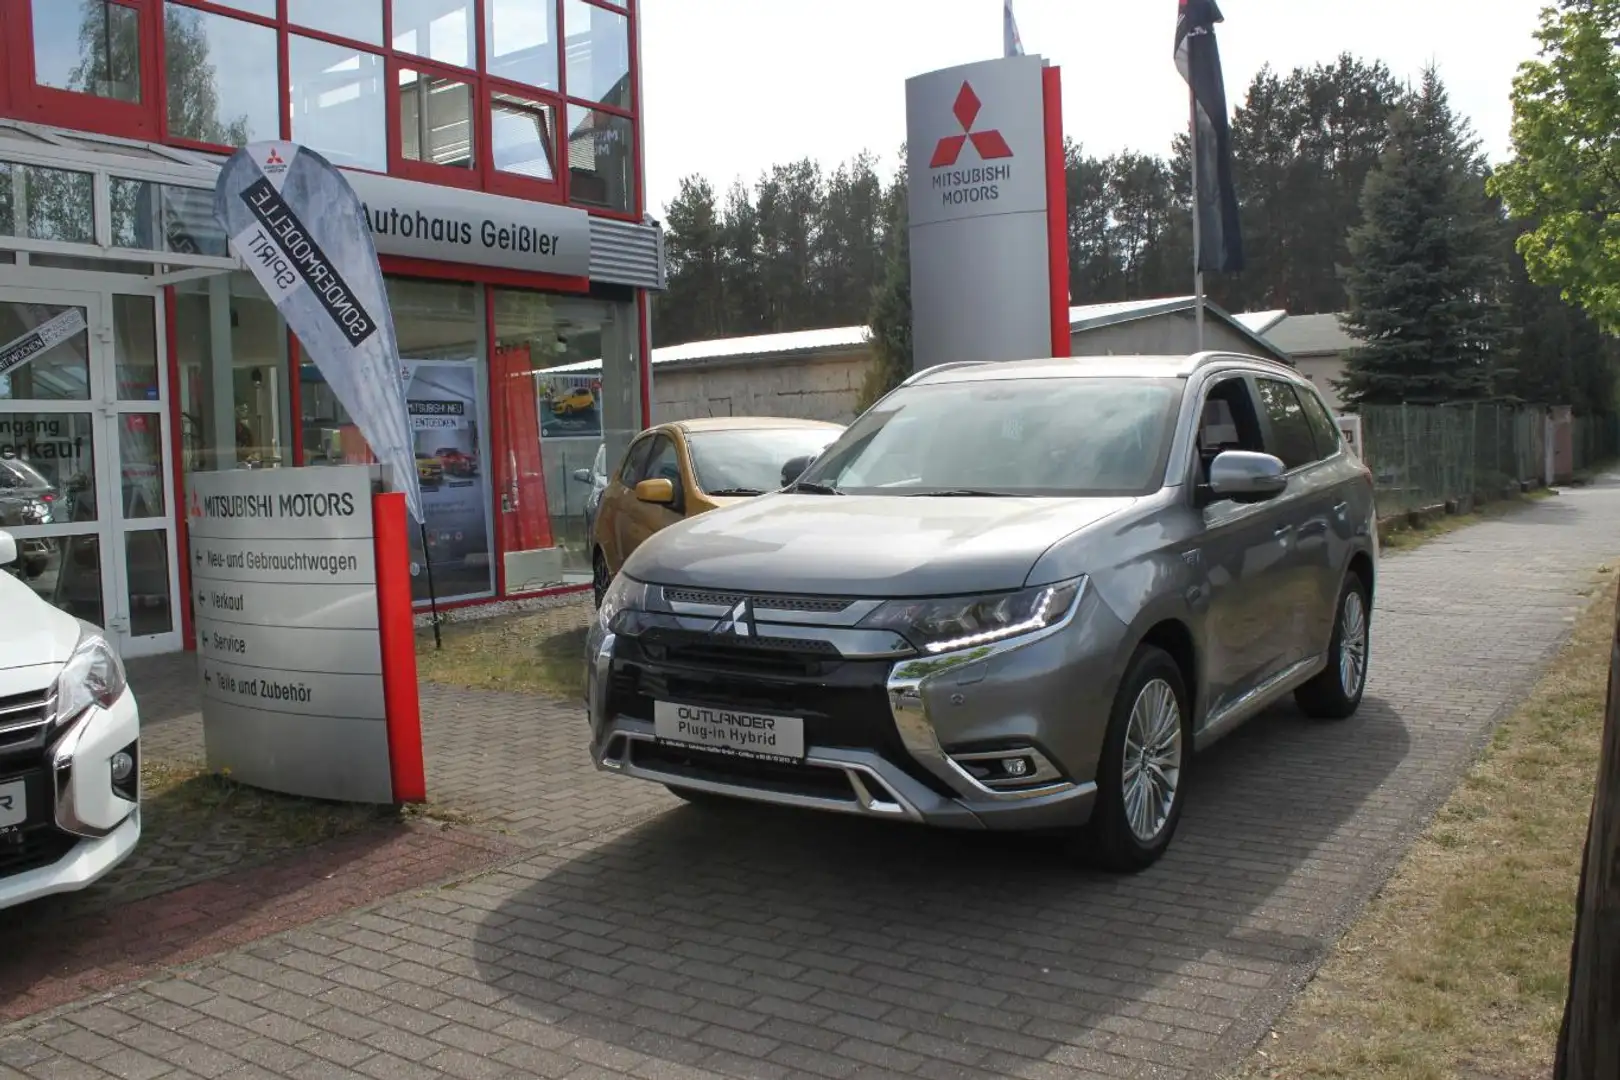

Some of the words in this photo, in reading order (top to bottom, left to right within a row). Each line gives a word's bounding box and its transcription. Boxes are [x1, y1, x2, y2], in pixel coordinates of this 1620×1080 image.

[932, 164, 1010, 188] MITSUBISHI
[942, 185, 999, 206] MOTORS
[362, 202, 472, 245] Autohaus
[481, 220, 559, 256] Geißler
[204, 494, 273, 518] MITSUBISHI
[280, 492, 354, 517] MOTORS
[246, 551, 357, 574] Gebrauchtwagen
[211, 592, 244, 611] Verkauf
[213, 632, 246, 653] Service
[216, 672, 236, 692] Teile
[238, 679, 257, 696] und
[260, 680, 312, 703] Zubehör
[678, 707, 775, 730] OUTLANDER
[678, 721, 725, 738] Plug-in
[729, 728, 776, 746] Hybrid
